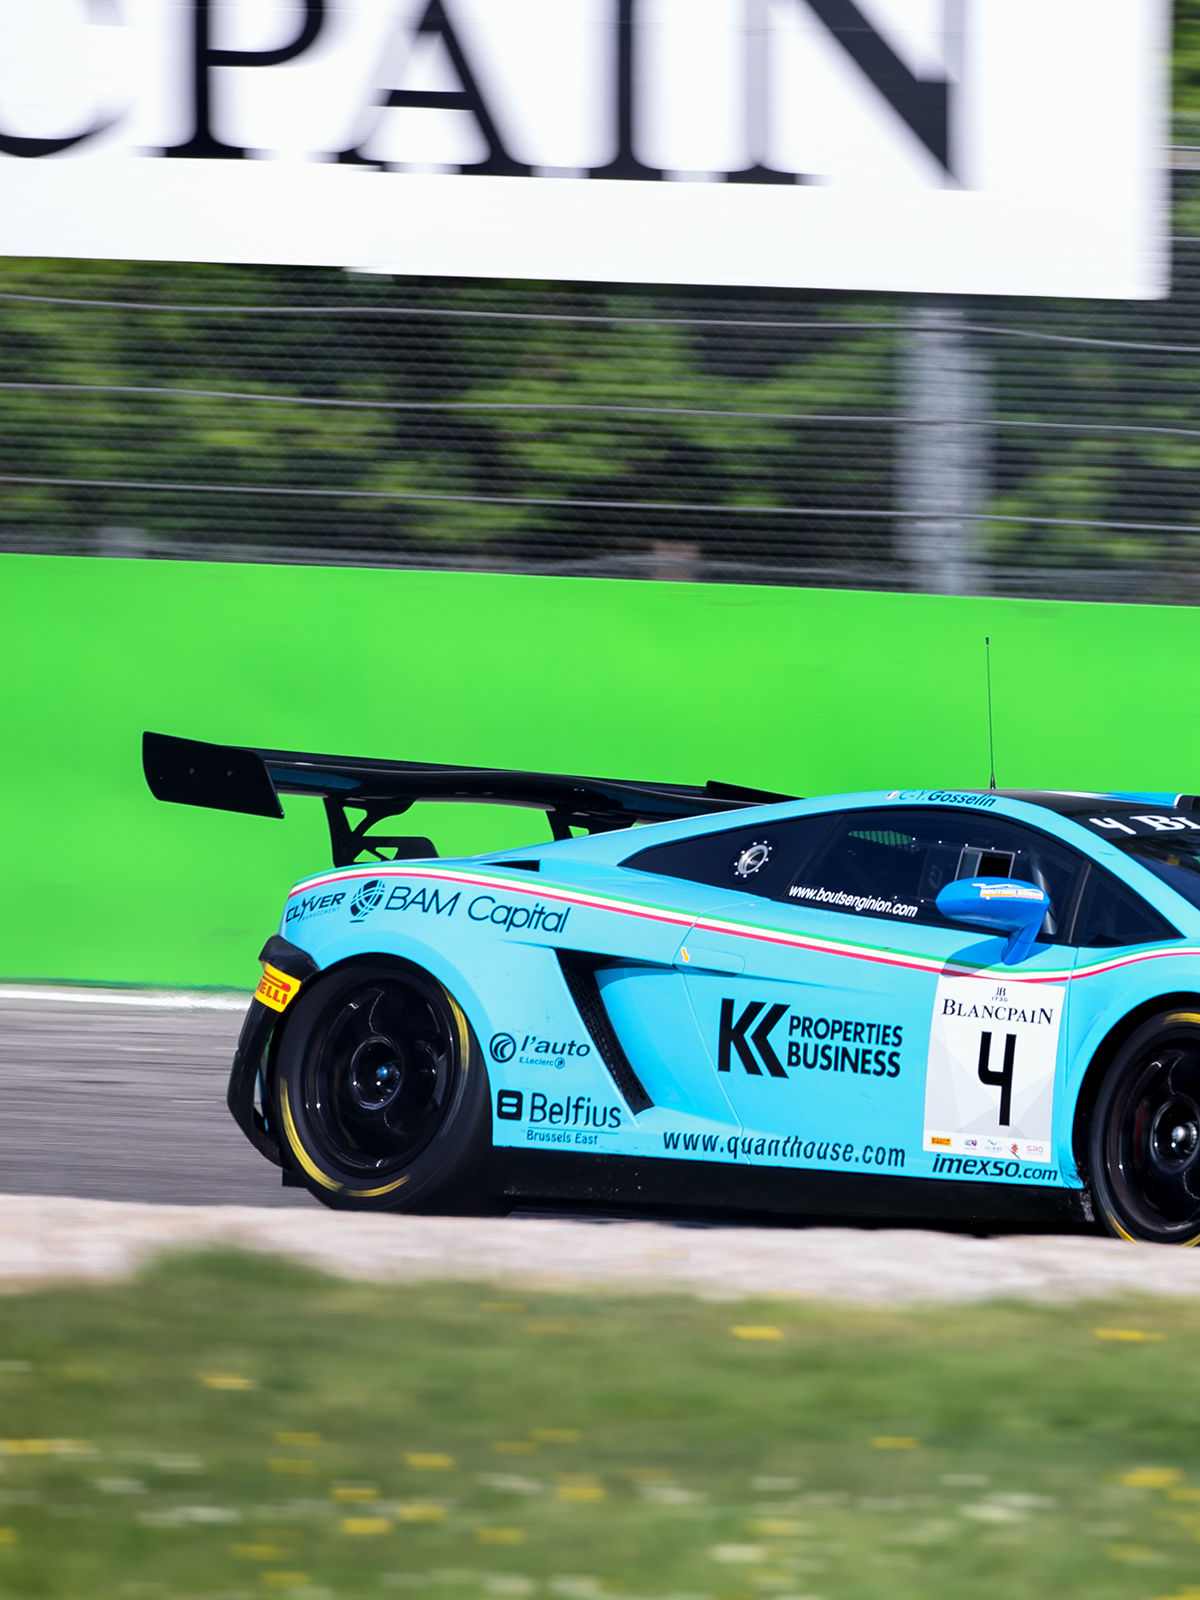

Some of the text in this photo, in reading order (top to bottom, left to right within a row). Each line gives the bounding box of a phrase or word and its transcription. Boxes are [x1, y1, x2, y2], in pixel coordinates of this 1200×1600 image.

[927, 791, 997, 807] Gosselin
[1089, 817, 1136, 835] 4
[285, 892, 347, 923] CLYVER
[384, 886, 571, 933] BAM Capital
[788, 885, 919, 918] www.boutsenginion.com
[941, 998, 1053, 1025] BLANCPAIN
[788, 1015, 903, 1048] PROPERTIES
[787, 1041, 901, 1078] BUSINESS
[978, 1031, 1017, 1126] 4
[529, 1092, 622, 1129] Belfius
[526, 1129, 599, 1145] Brussels East
[663, 1131, 906, 1168] www.quanthouse.com
[932, 1153, 1058, 1181] imexso.com
